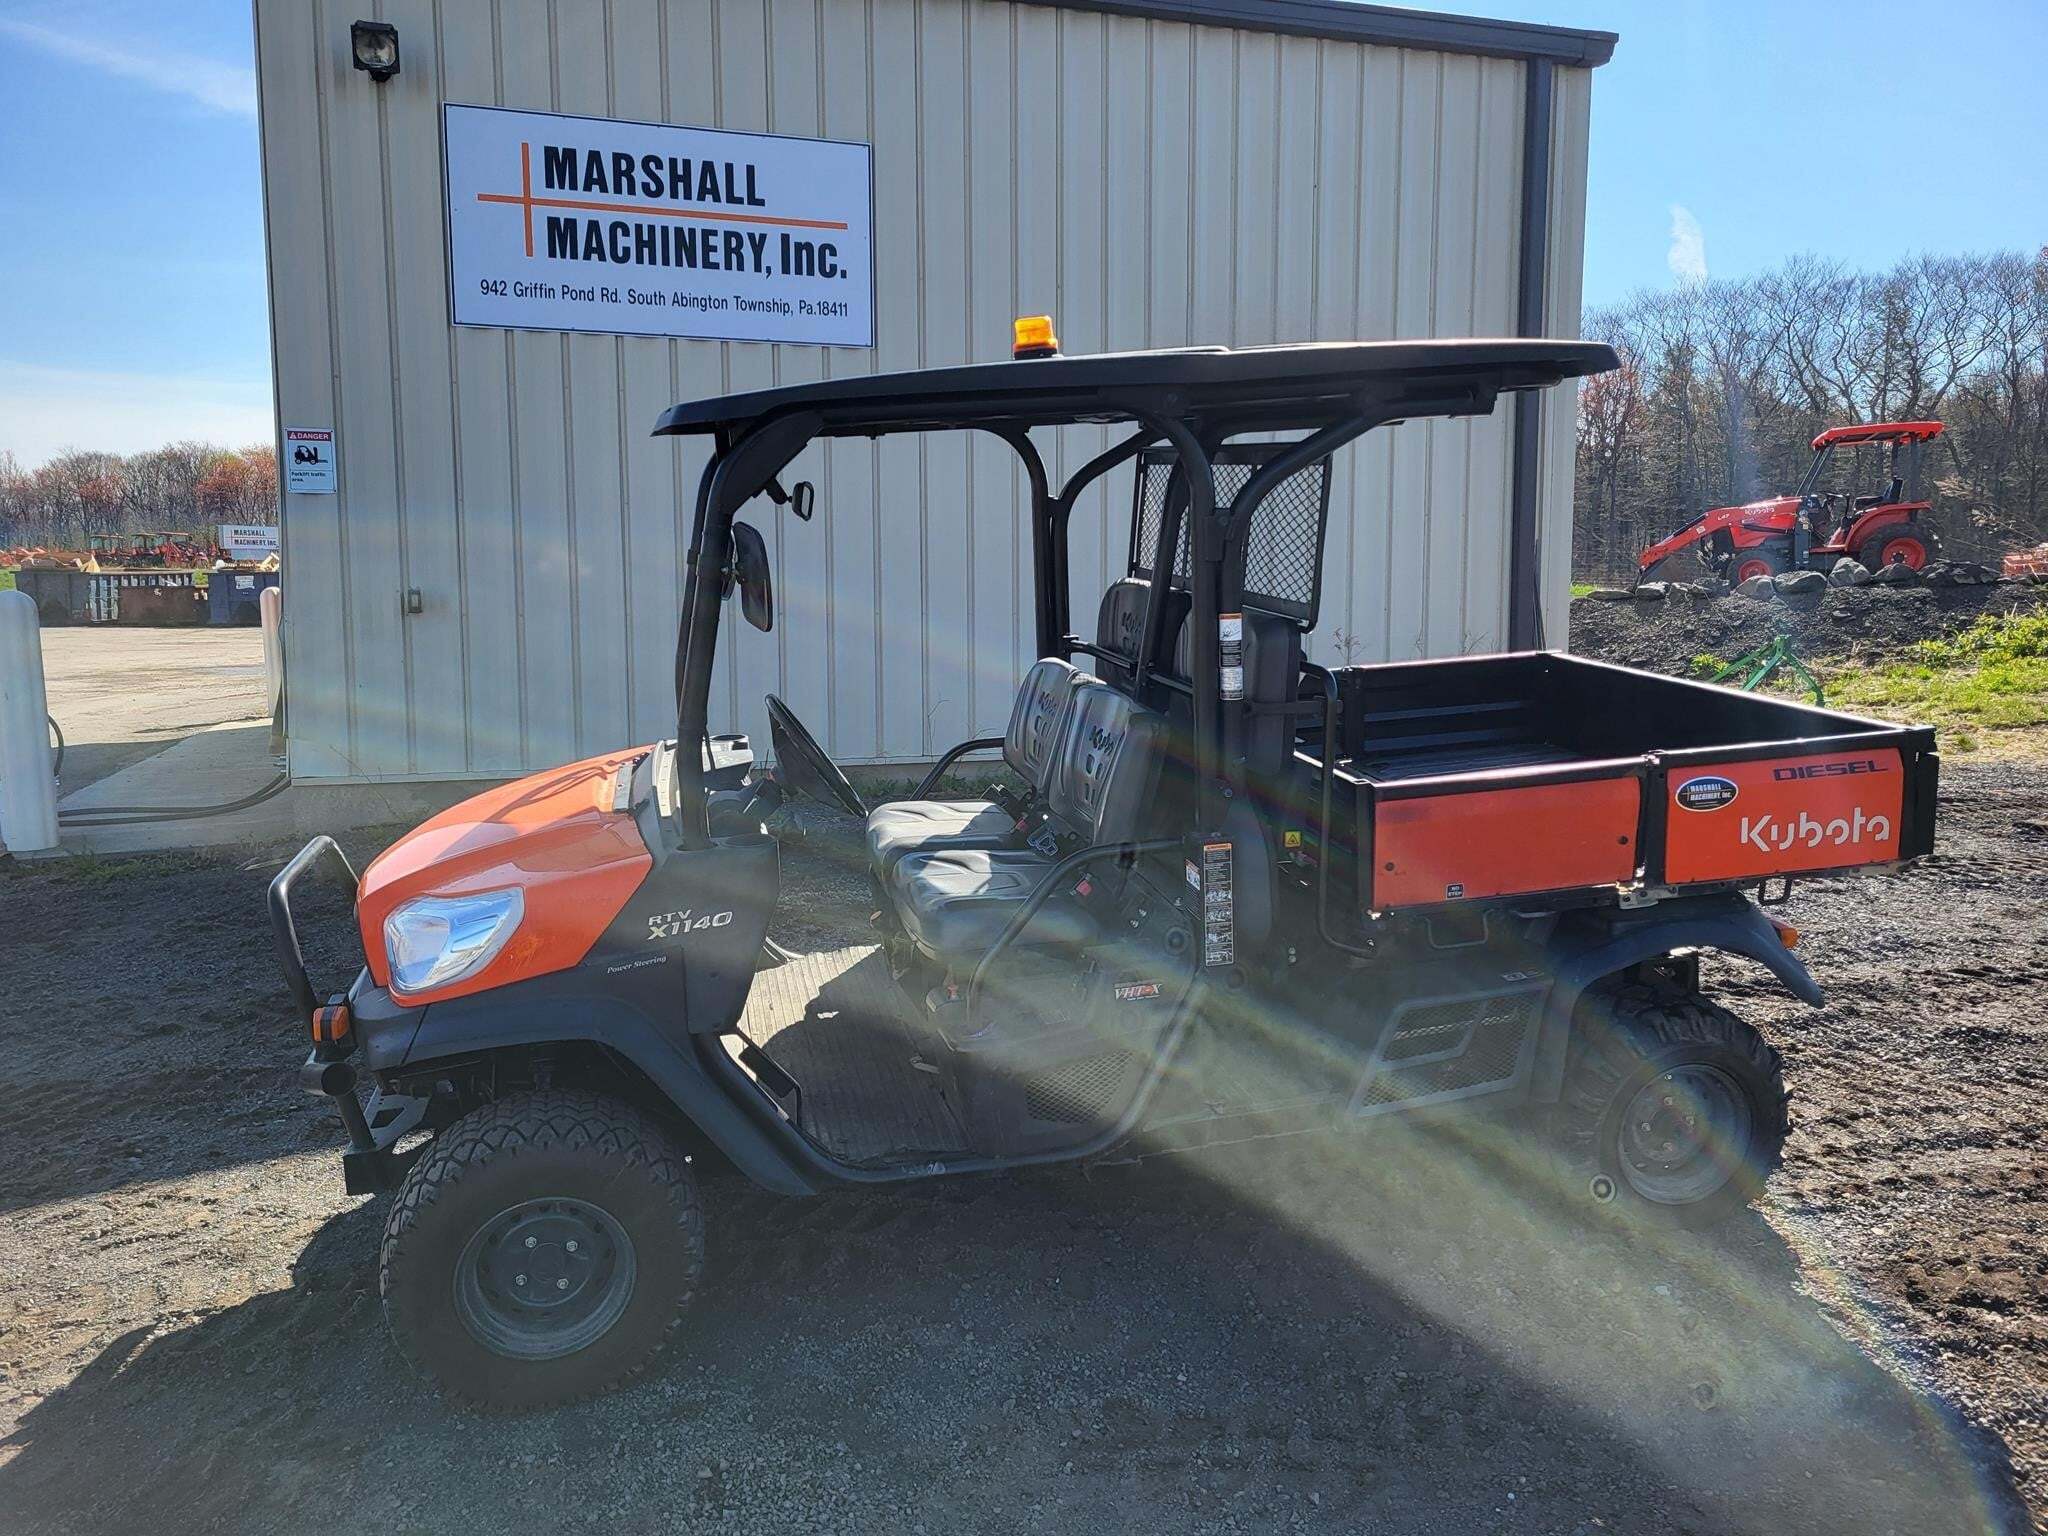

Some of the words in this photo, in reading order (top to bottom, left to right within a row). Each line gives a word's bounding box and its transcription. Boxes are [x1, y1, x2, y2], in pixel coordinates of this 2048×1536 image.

[543, 145, 766, 207] MARSHALL
[546, 215, 772, 280] MACHINERY,
[780, 232, 848, 279] Inc.
[480, 279, 508, 297] 942
[513, 281, 556, 300] Griffin
[561, 284, 595, 302] Pond
[600, 287, 622, 304] Rd.
[627, 288, 667, 306] South
[671, 291, 729, 312] Abington
[733, 295, 794, 316] Township,
[233, 529, 266, 537] MARSHALL
[1772, 759, 1889, 781] DIESEL
[1690, 783, 1722, 792] MARSHALL
[1740, 806, 1890, 852] Kubota
[647, 911, 733, 940] X1140
[648, 909, 692, 926] RTV
[607, 963, 633, 974] Power
[633, 955, 667, 969] Steering
